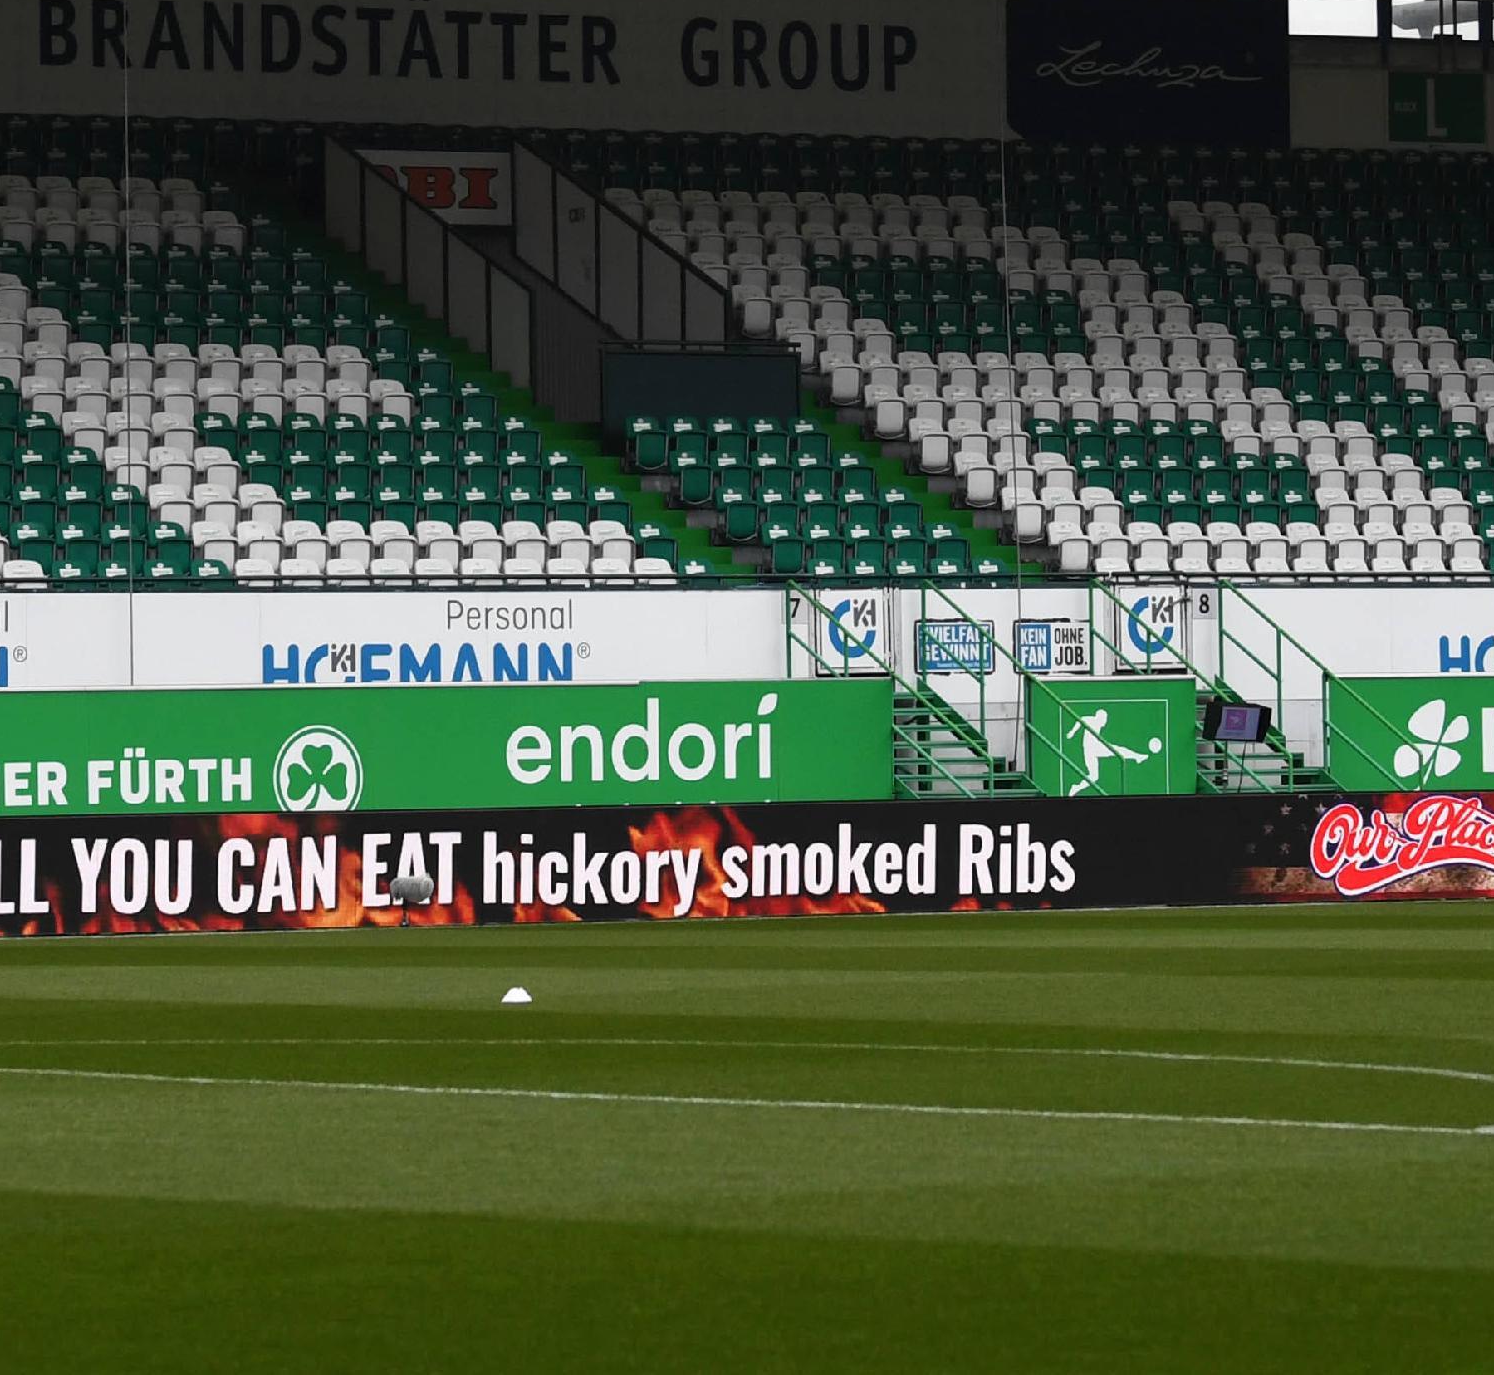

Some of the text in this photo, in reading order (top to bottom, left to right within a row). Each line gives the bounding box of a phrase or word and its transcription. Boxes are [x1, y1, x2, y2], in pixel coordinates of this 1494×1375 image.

[680, 17, 920, 93] GROUP
[1426, 77, 1448, 138] L
[370, 163, 499, 210] BI
[446, 599, 575, 632] Personal
[790, 597, 801, 619] 7
[1198, 593, 1210, 614] 8
[1020, 627, 1048, 645] KEIN
[1054, 627, 1085, 644] OHNE
[1020, 645, 1048, 667] FAN
[1054, 645, 1088, 666] JOB.
[87, 747, 253, 806] FÜRTH
[70, 837, 194, 915] YOU
[215, 834, 338, 913] CAN
[360, 830, 463, 907] EAT
[482, 829, 703, 917] hickory
[721, 822, 937, 900] smoked
[957, 822, 1077, 896] Ribs
